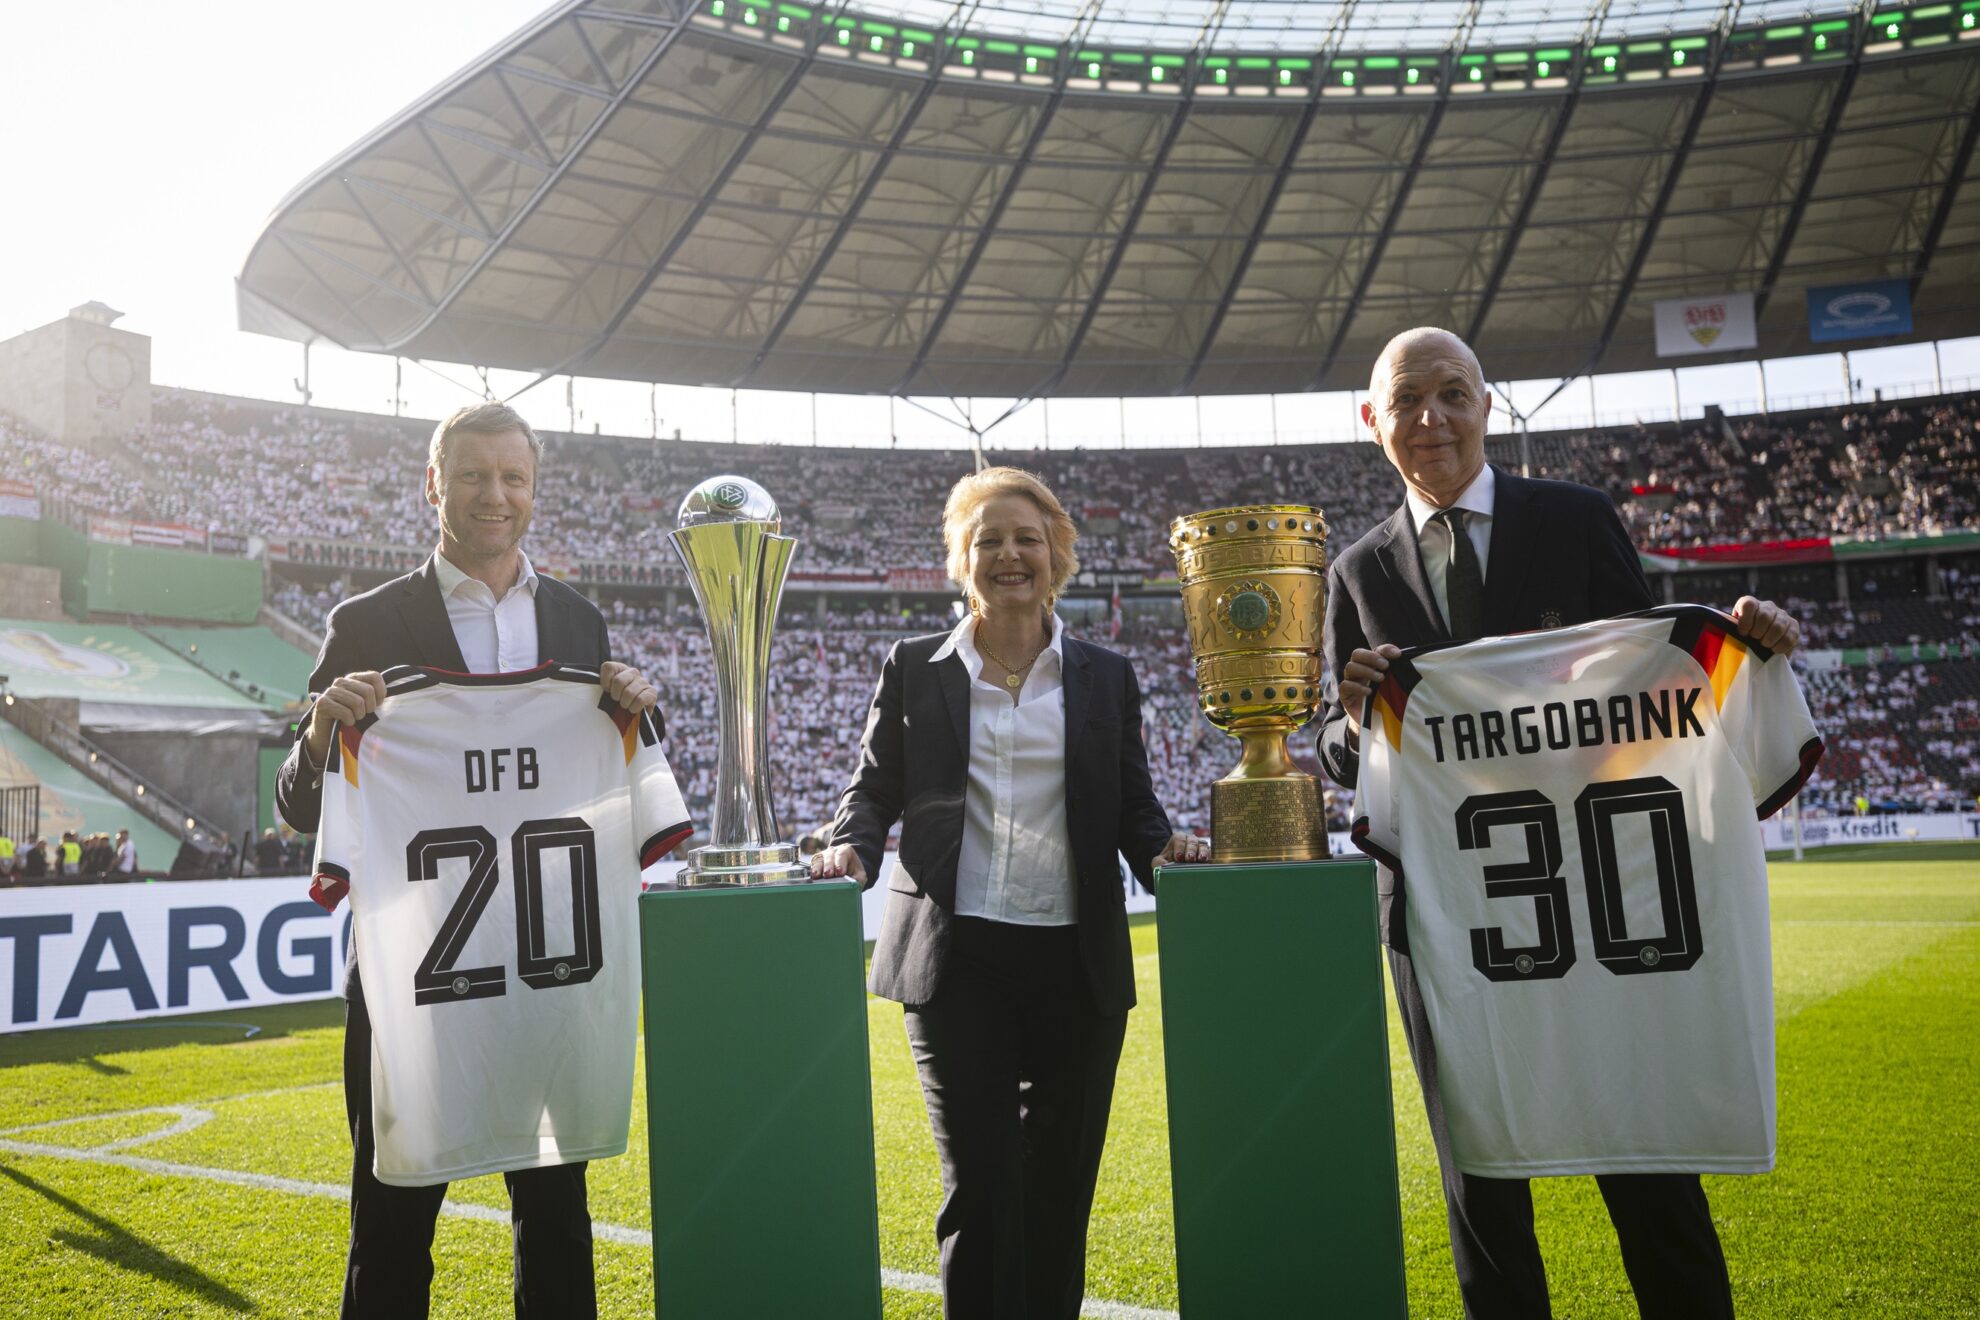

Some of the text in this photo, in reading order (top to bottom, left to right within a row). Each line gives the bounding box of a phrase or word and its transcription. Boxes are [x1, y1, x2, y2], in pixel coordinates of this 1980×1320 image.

[464, 747, 539, 793] DFB
[1424, 688, 1706, 763] TARGOBANK
[406, 816, 604, 1006] 20
[1454, 775, 1704, 983] 30
[0, 900, 353, 1024] TARG
